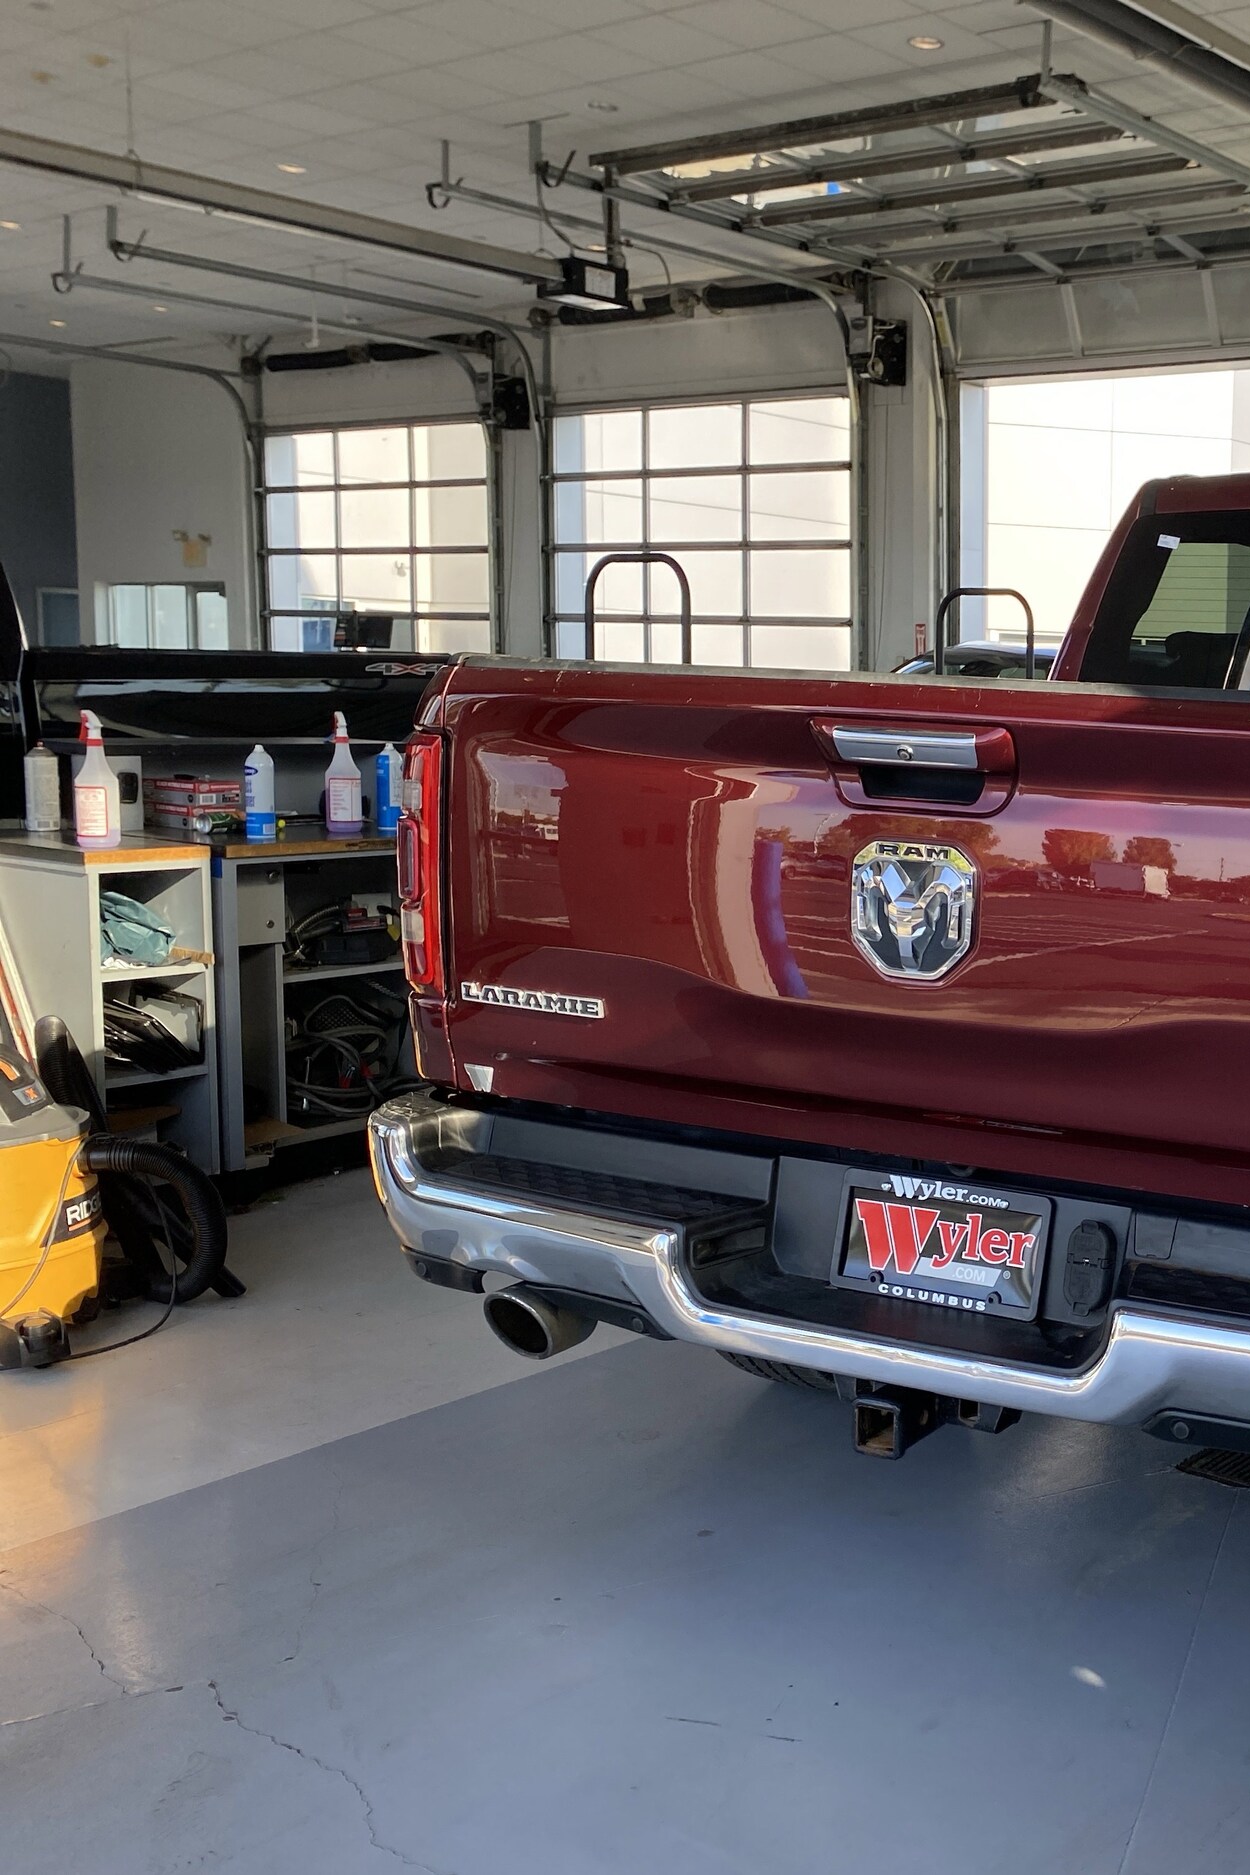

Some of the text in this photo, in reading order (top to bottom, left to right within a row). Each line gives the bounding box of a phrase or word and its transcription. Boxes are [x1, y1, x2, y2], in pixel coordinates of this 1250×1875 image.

[877, 843, 950, 860] RAM
[462, 983, 603, 1018] LARAMIE
[66, 1191, 101, 1226] RIDG
[855, 1198, 1036, 1275] Wyler
[952, 1266, 986, 1283] .COM
[877, 1283, 987, 1312] COLUMBUS
